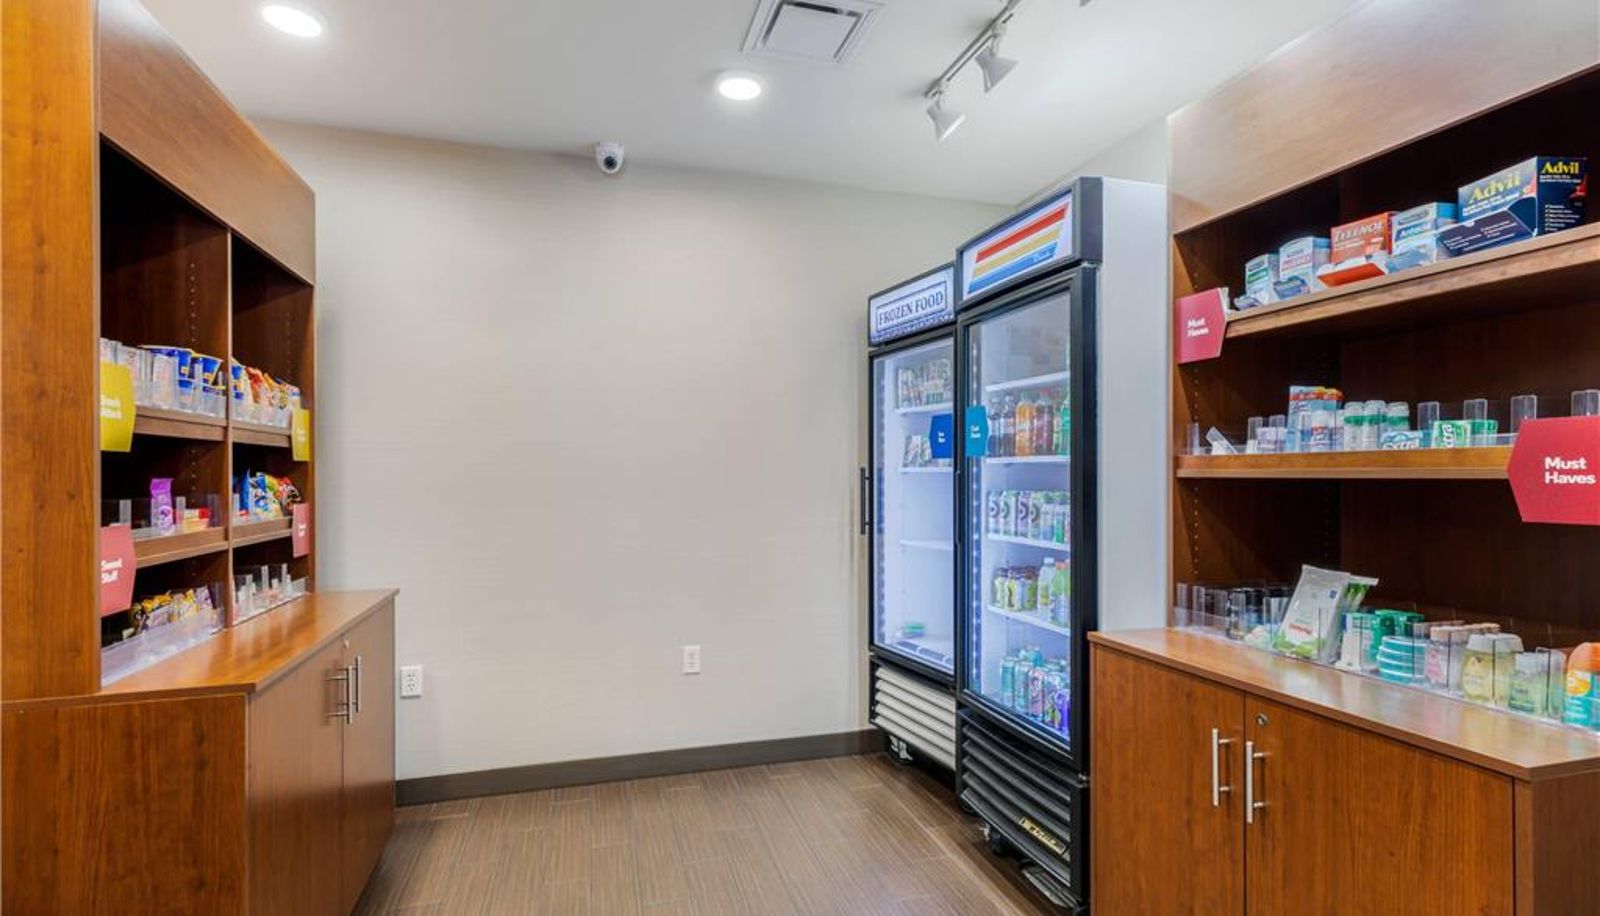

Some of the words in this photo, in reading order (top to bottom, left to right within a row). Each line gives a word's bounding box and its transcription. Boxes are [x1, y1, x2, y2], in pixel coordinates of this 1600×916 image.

[1541, 161, 1580, 174] Advil
[1468, 175, 1520, 204] Advil
[878, 302, 913, 326] FROZEN
[914, 290, 944, 313] FOOD
[1544, 456, 1588, 470] Must
[1544, 471, 1597, 485] Haves
